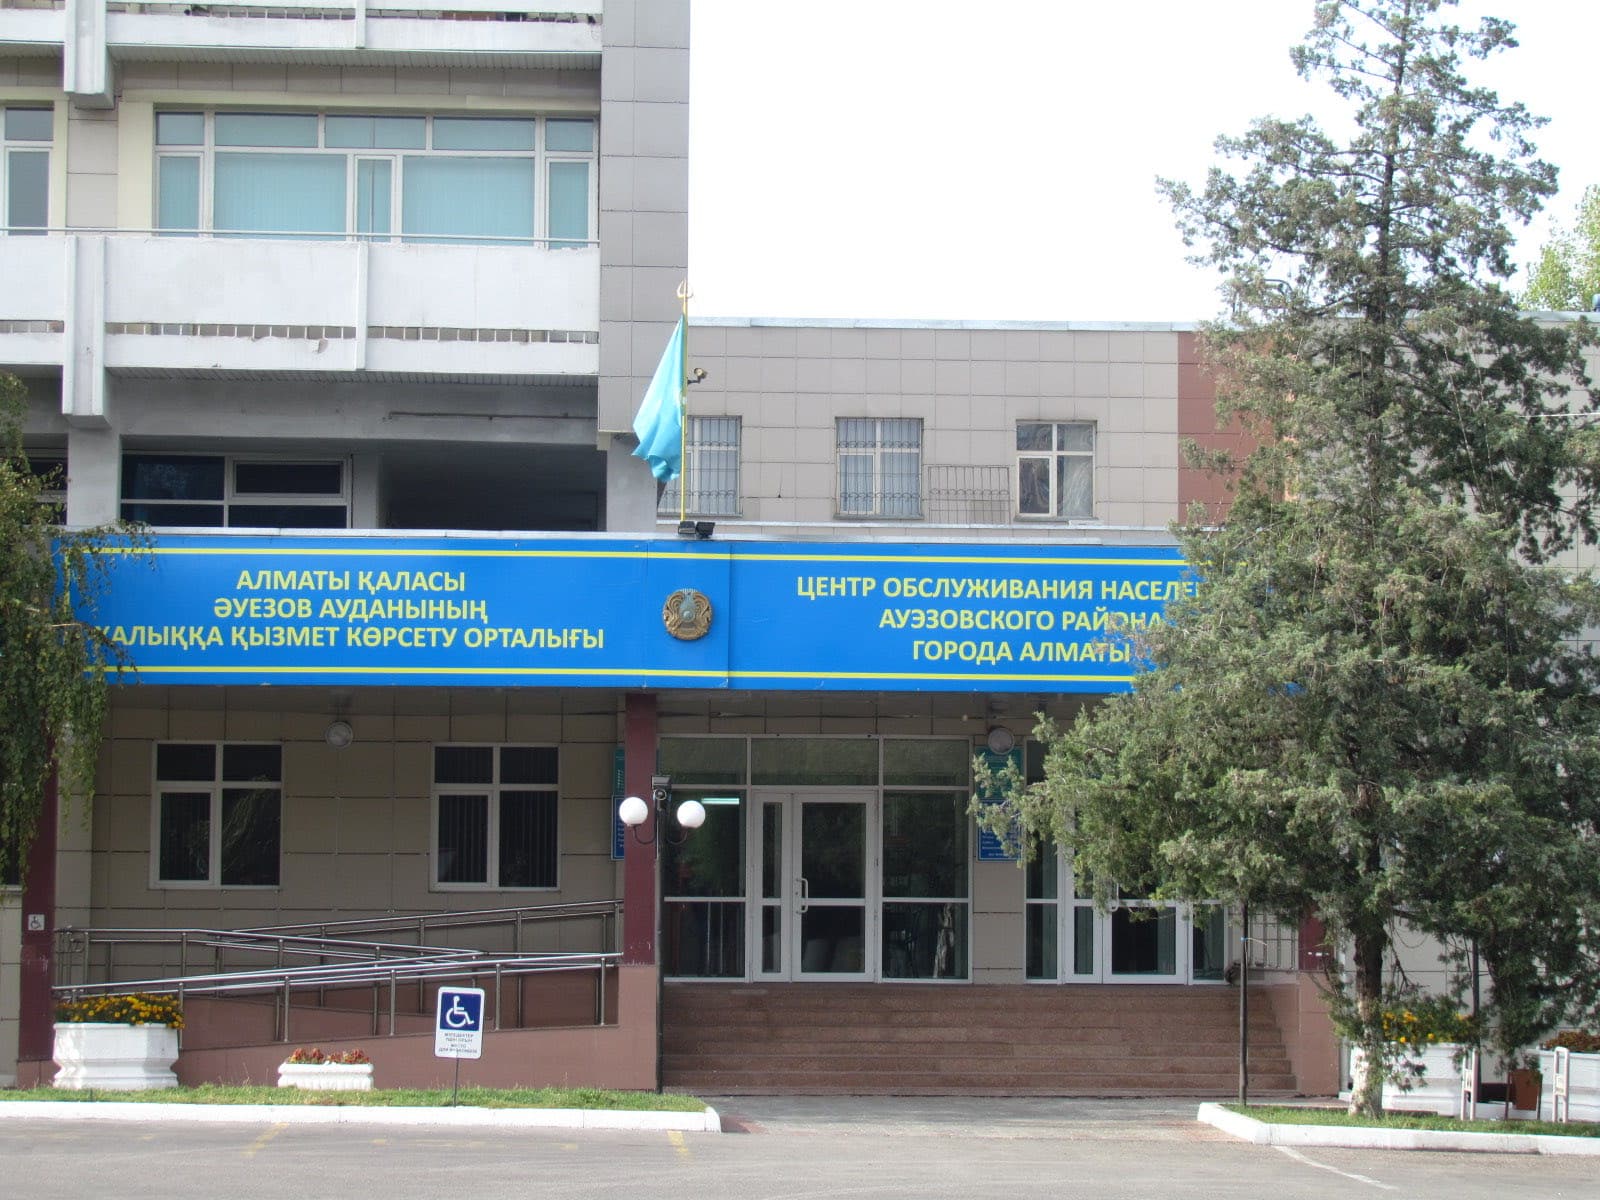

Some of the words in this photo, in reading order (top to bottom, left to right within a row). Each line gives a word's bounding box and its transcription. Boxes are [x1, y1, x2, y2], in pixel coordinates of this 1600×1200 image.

[236, 570, 350, 591] АЛМАТЫ
[358, 571, 465, 595] ҚАЛАСЫ
[797, 576, 876, 600] ЦЕНТР
[883, 577, 1093, 600] ОБСЛУЖИВАНИЯ
[214, 597, 313, 618] ӘУЕЗОВ
[319, 598, 488, 624] АУДАНЫНЫҢ
[879, 608, 1055, 631] АУЭЗОВСКОГО
[1062, 606, 1164, 632] РАЙОНА
[231, 626, 340, 650] ҚЫЗМЕТ
[347, 626, 457, 648] КӨРСЕТУ
[464, 627, 604, 649] ОРТАЛЫҒЫ
[913, 640, 1013, 665] ГОРОДА
[1020, 641, 1131, 663] АЛМАТЫ
